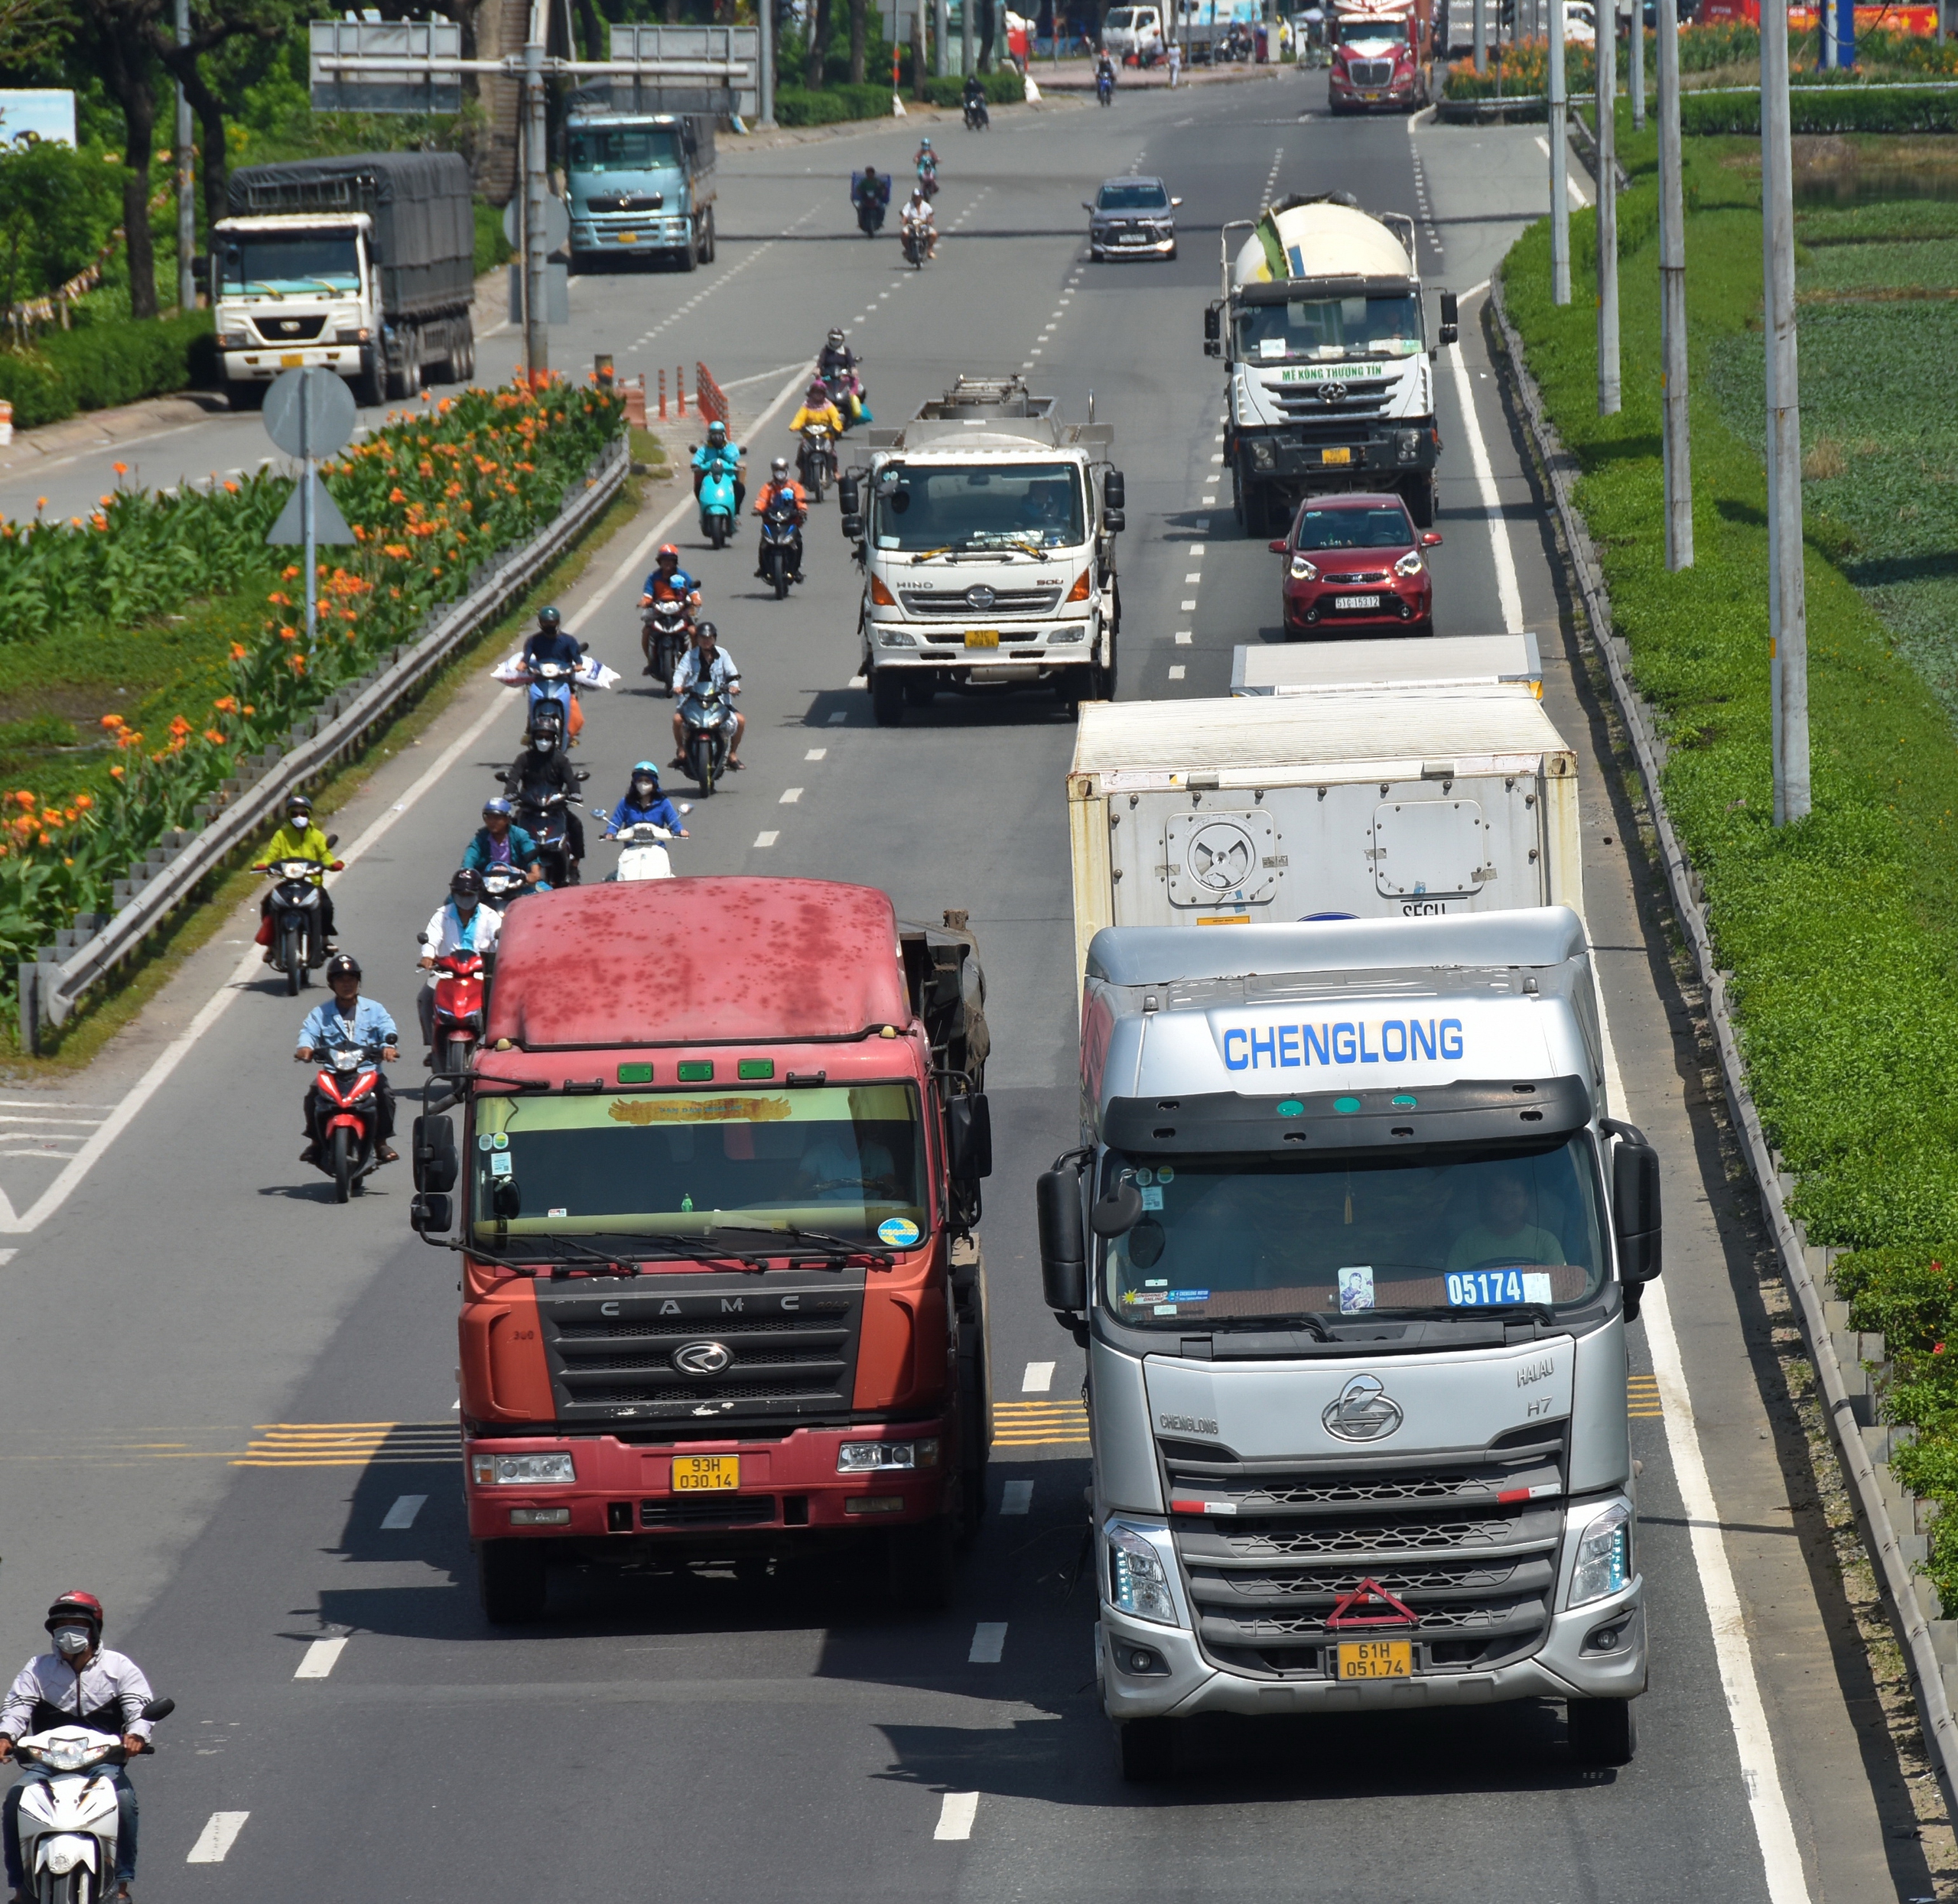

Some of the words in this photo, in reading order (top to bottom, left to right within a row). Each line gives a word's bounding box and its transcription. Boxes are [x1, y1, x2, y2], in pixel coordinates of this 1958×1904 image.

[1298, 366, 1324, 379] KÔNG
[1224, 1019, 1463, 1071] CHENGLONG
[1448, 1272, 1521, 1305] 05174
[600, 1295, 799, 1316] CAMC
[1517, 1357, 1554, 1388] HALAU
[1527, 1396, 1553, 1417] H7
[1160, 1413, 1218, 1434] CHENGLONG
[691, 1458, 720, 1472] 93H
[680, 1473, 732, 1488] 030.14
[1358, 1643, 1390, 1659] 61H
[1346, 1659, 1403, 1676] 051.74
